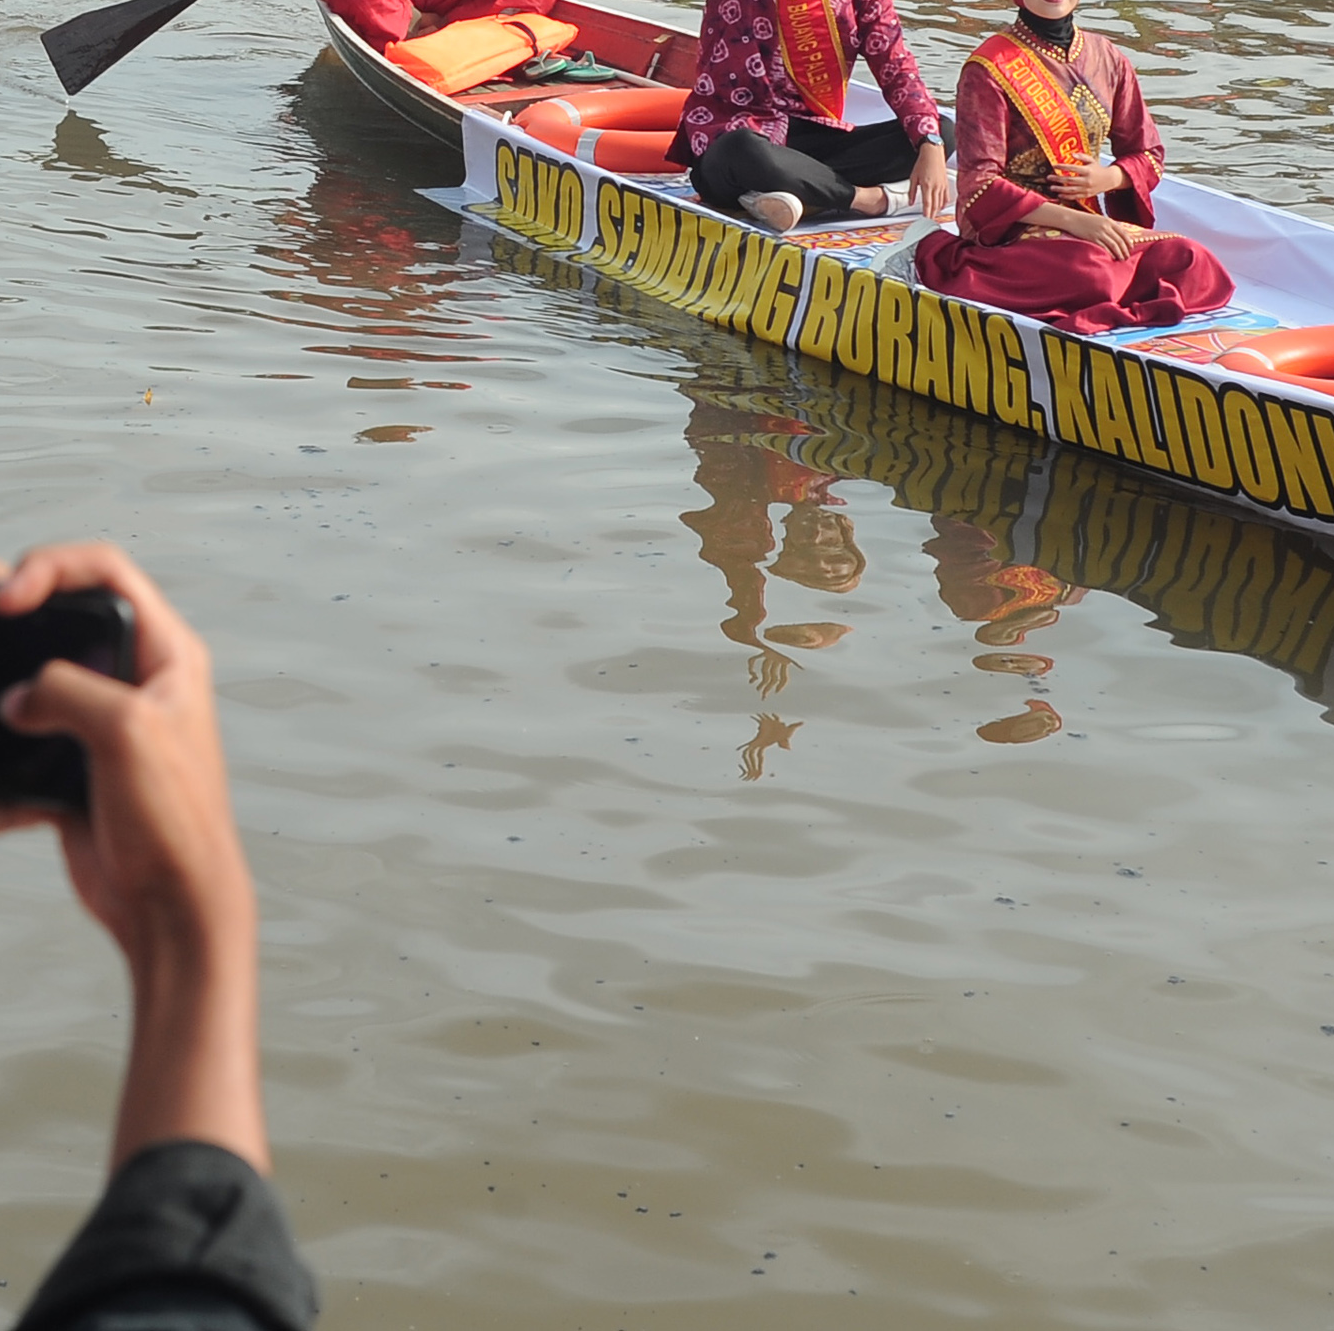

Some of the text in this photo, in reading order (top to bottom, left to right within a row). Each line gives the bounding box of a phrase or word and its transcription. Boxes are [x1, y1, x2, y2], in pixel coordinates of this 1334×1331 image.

[786, 2, 818, 52] BUJANG
[1005, 57, 1072, 142] FOTOGENIK
[568, 176, 806, 349] SEMATANG
